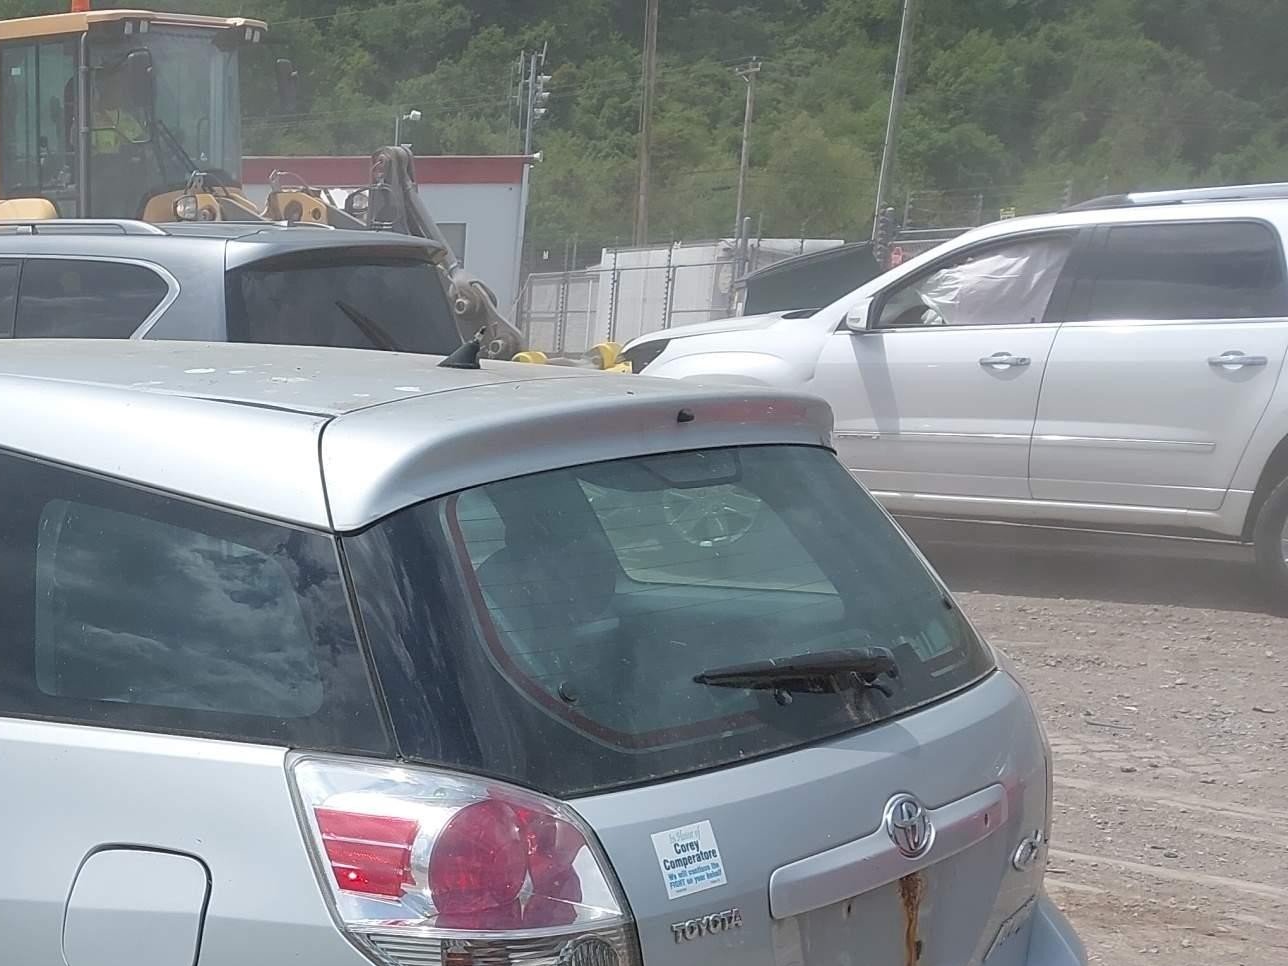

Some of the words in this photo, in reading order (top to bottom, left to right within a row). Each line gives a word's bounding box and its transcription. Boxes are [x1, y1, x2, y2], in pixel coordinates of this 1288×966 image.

[673, 840, 700, 854] Corey
[663, 849, 717, 870] Comperatore
[671, 908, 743, 944] TOYOTA
